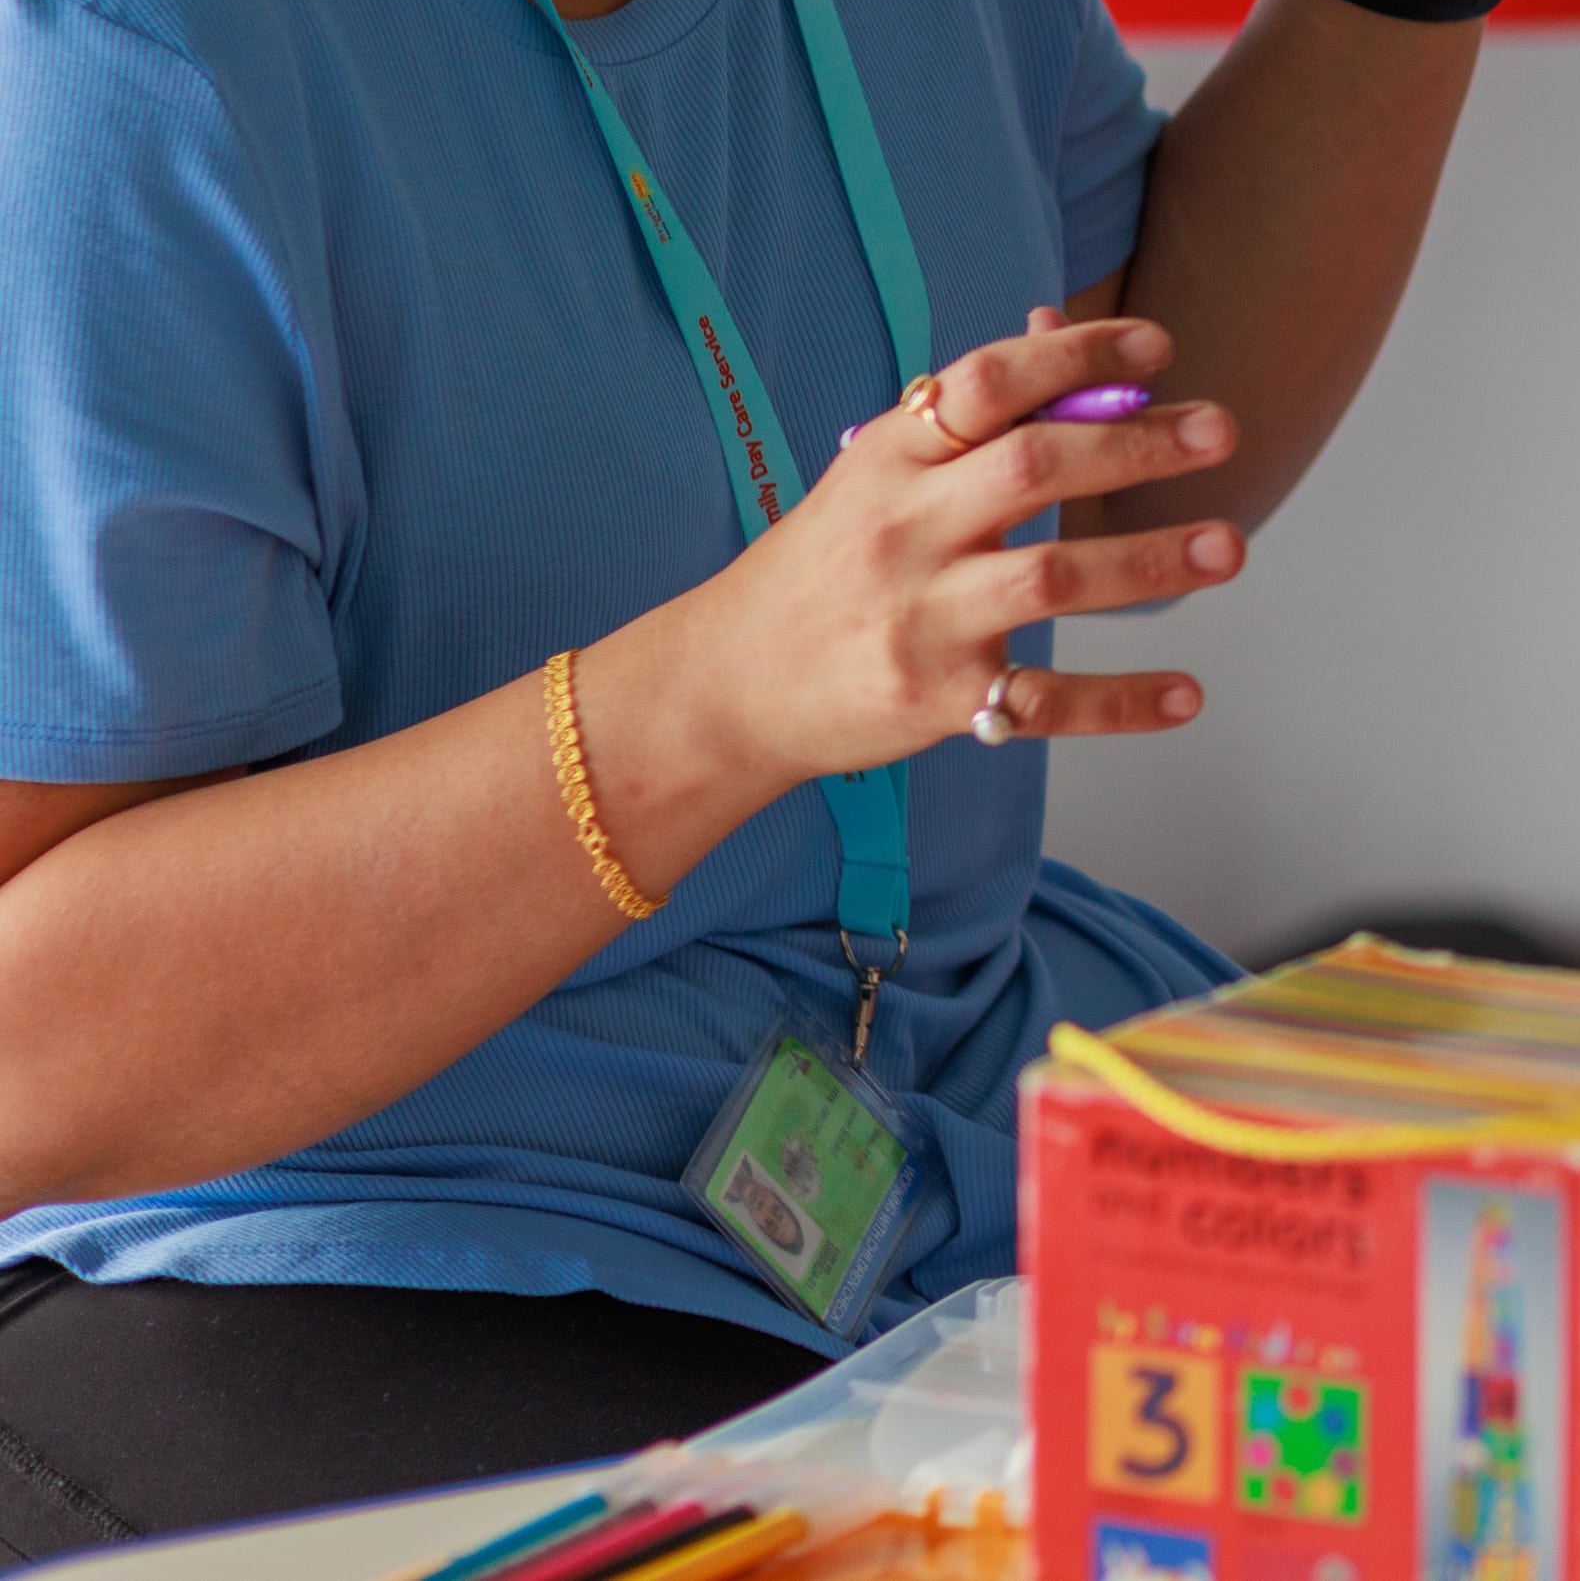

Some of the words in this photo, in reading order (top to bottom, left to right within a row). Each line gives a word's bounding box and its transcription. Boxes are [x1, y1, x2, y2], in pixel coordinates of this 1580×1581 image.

[698, 314, 736, 390] Service
[729, 389, 753, 439] Care
[745, 440, 769, 481] Day
[757, 482, 783, 526] mily
[883, 1164, 916, 1216] WORKING
[869, 1210, 892, 1242] WITH
[846, 1236, 879, 1289] CHILDREN
[829, 1284, 854, 1324] CHECK
[1117, 1361, 1190, 1482] 3
